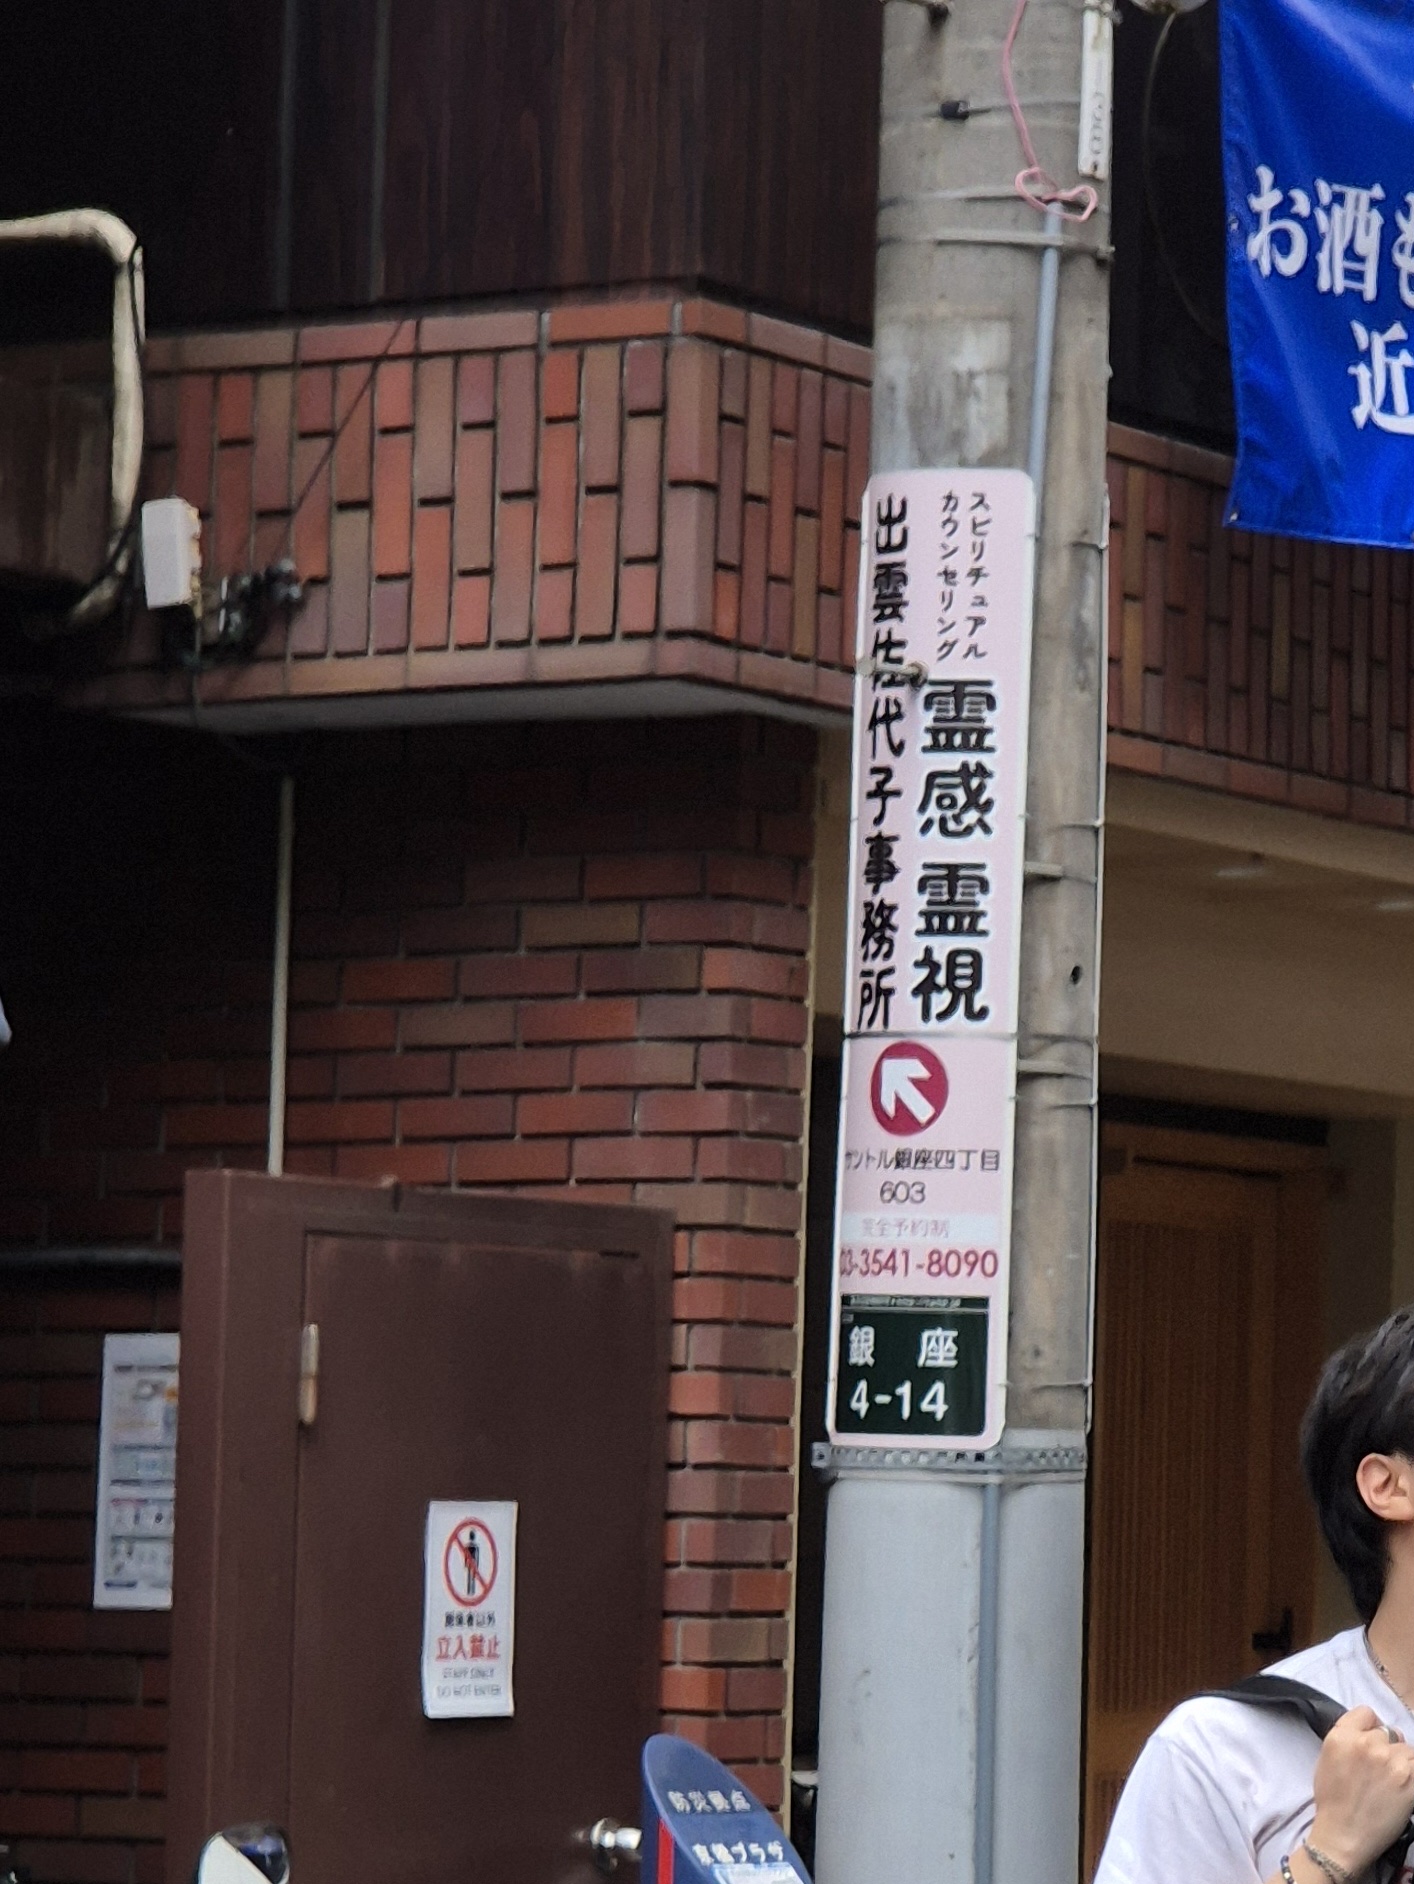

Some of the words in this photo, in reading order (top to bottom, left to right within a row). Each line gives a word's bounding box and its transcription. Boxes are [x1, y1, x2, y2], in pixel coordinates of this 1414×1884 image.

[936, 489, 960, 662] カウンセリング
[962, 491, 993, 660] スピリチュアル
[911, 678, 997, 1024] 霊感霊視
[879, 1180, 927, 1204] 603
[847, 1325, 959, 1369] 銀座
[849, 1379, 949, 1422] 4-14
[436, 1633, 500, 1660] 立入禁止
